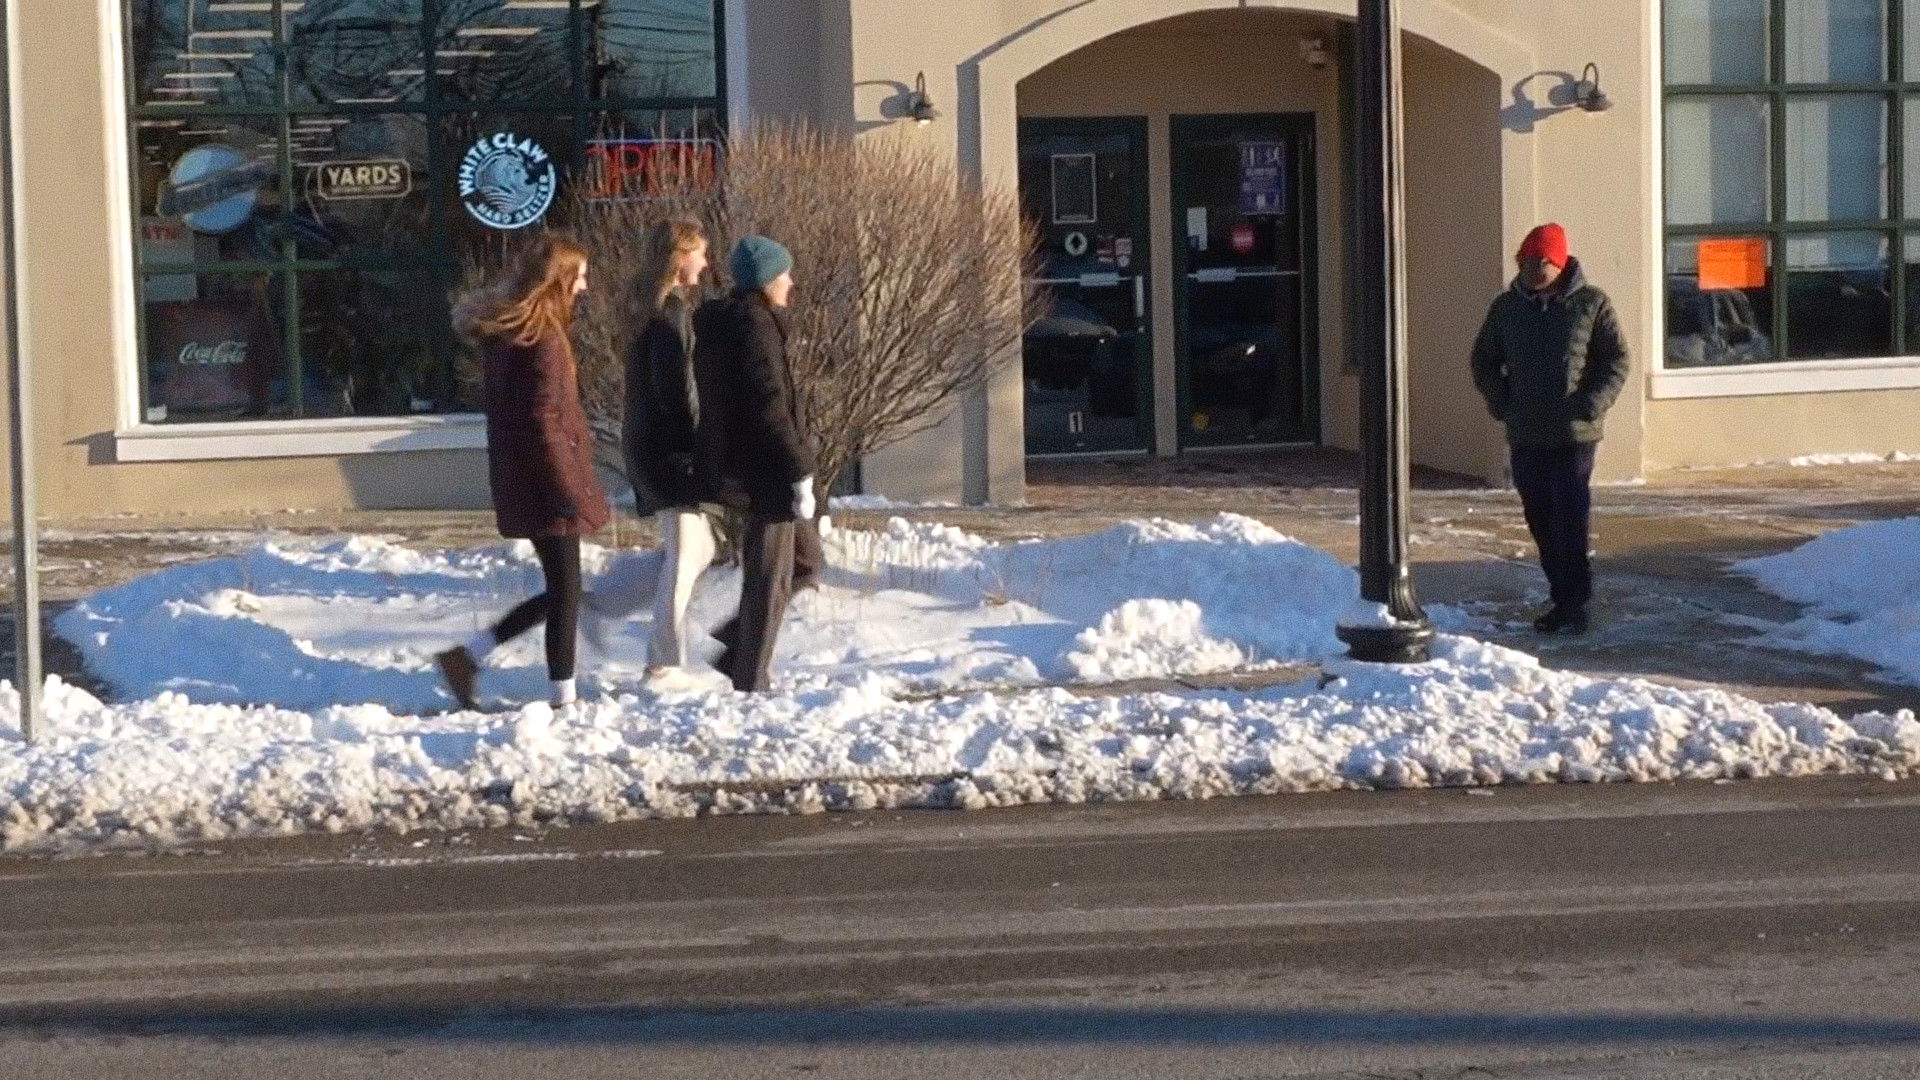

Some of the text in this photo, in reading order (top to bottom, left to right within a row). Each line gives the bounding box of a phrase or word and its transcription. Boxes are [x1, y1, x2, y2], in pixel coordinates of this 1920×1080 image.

[327, 163, 401, 186] YARDS
[458, 132, 549, 197] WHITE CLAW
